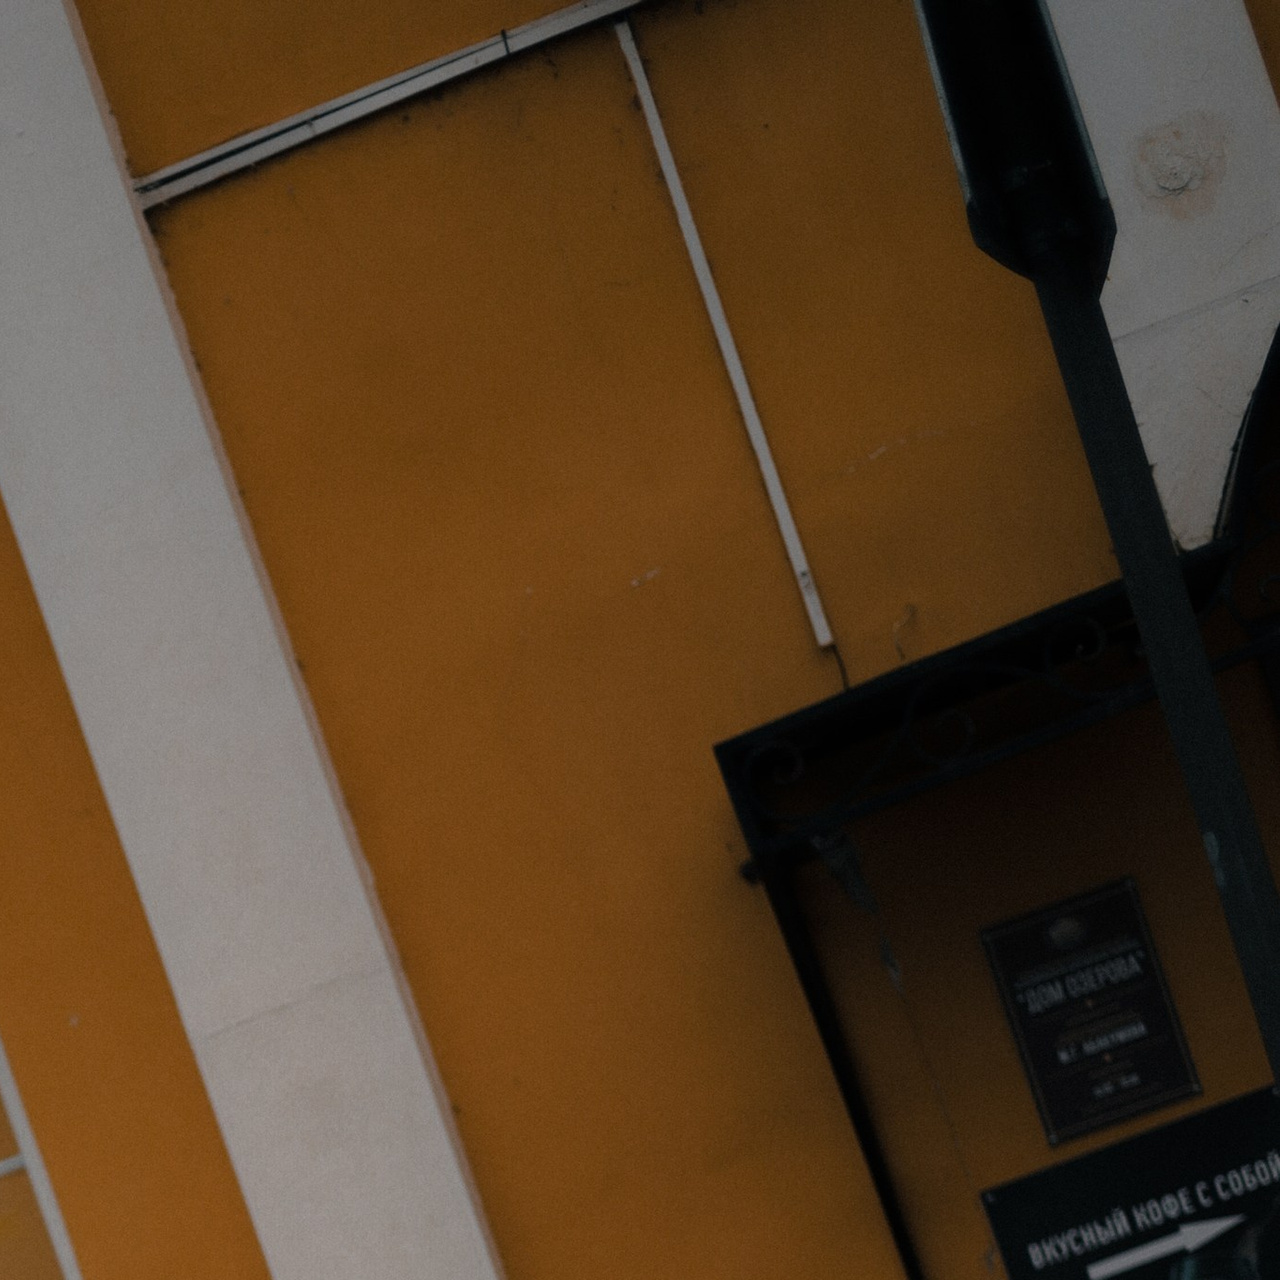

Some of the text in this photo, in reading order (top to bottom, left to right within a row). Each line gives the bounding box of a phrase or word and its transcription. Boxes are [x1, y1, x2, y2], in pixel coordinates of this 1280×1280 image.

[1027, 1206, 1133, 1271] ВКУСНЫЙ
[1131, 1186, 1197, 1231] КОФЕ
[1194, 1180, 1214, 1208] С
